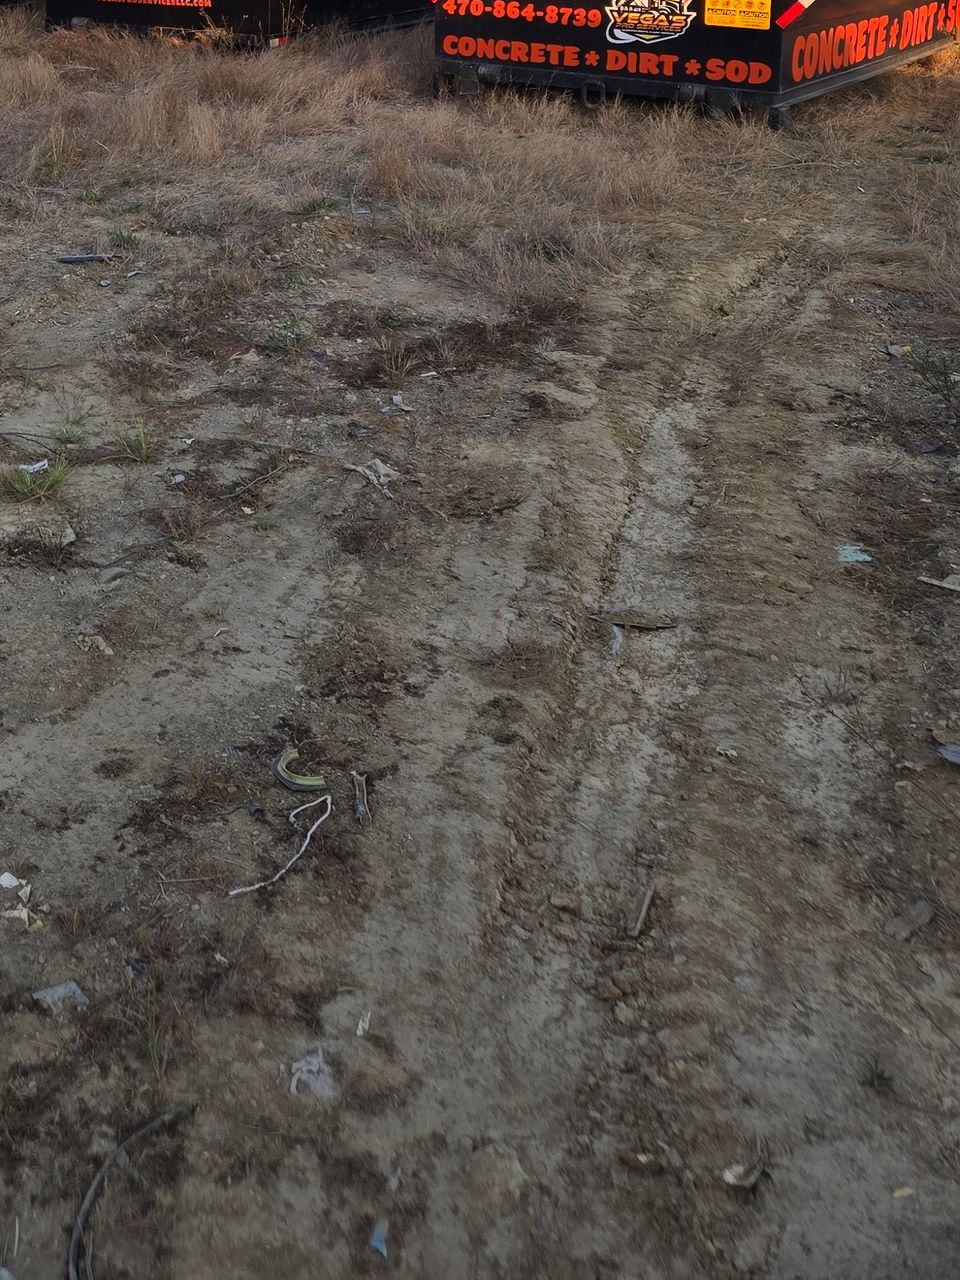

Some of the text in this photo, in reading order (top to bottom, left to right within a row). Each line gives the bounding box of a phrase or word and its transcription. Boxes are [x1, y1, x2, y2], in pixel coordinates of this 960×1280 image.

[612, 11, 687, 27] VEGA'S
[636, 24, 681, 32] SERVICES
[792, 14, 889, 83] CONCRETE
[899, 1, 938, 51] DIRT
[442, 34, 772, 85] CONCRETE DIRT SOD
